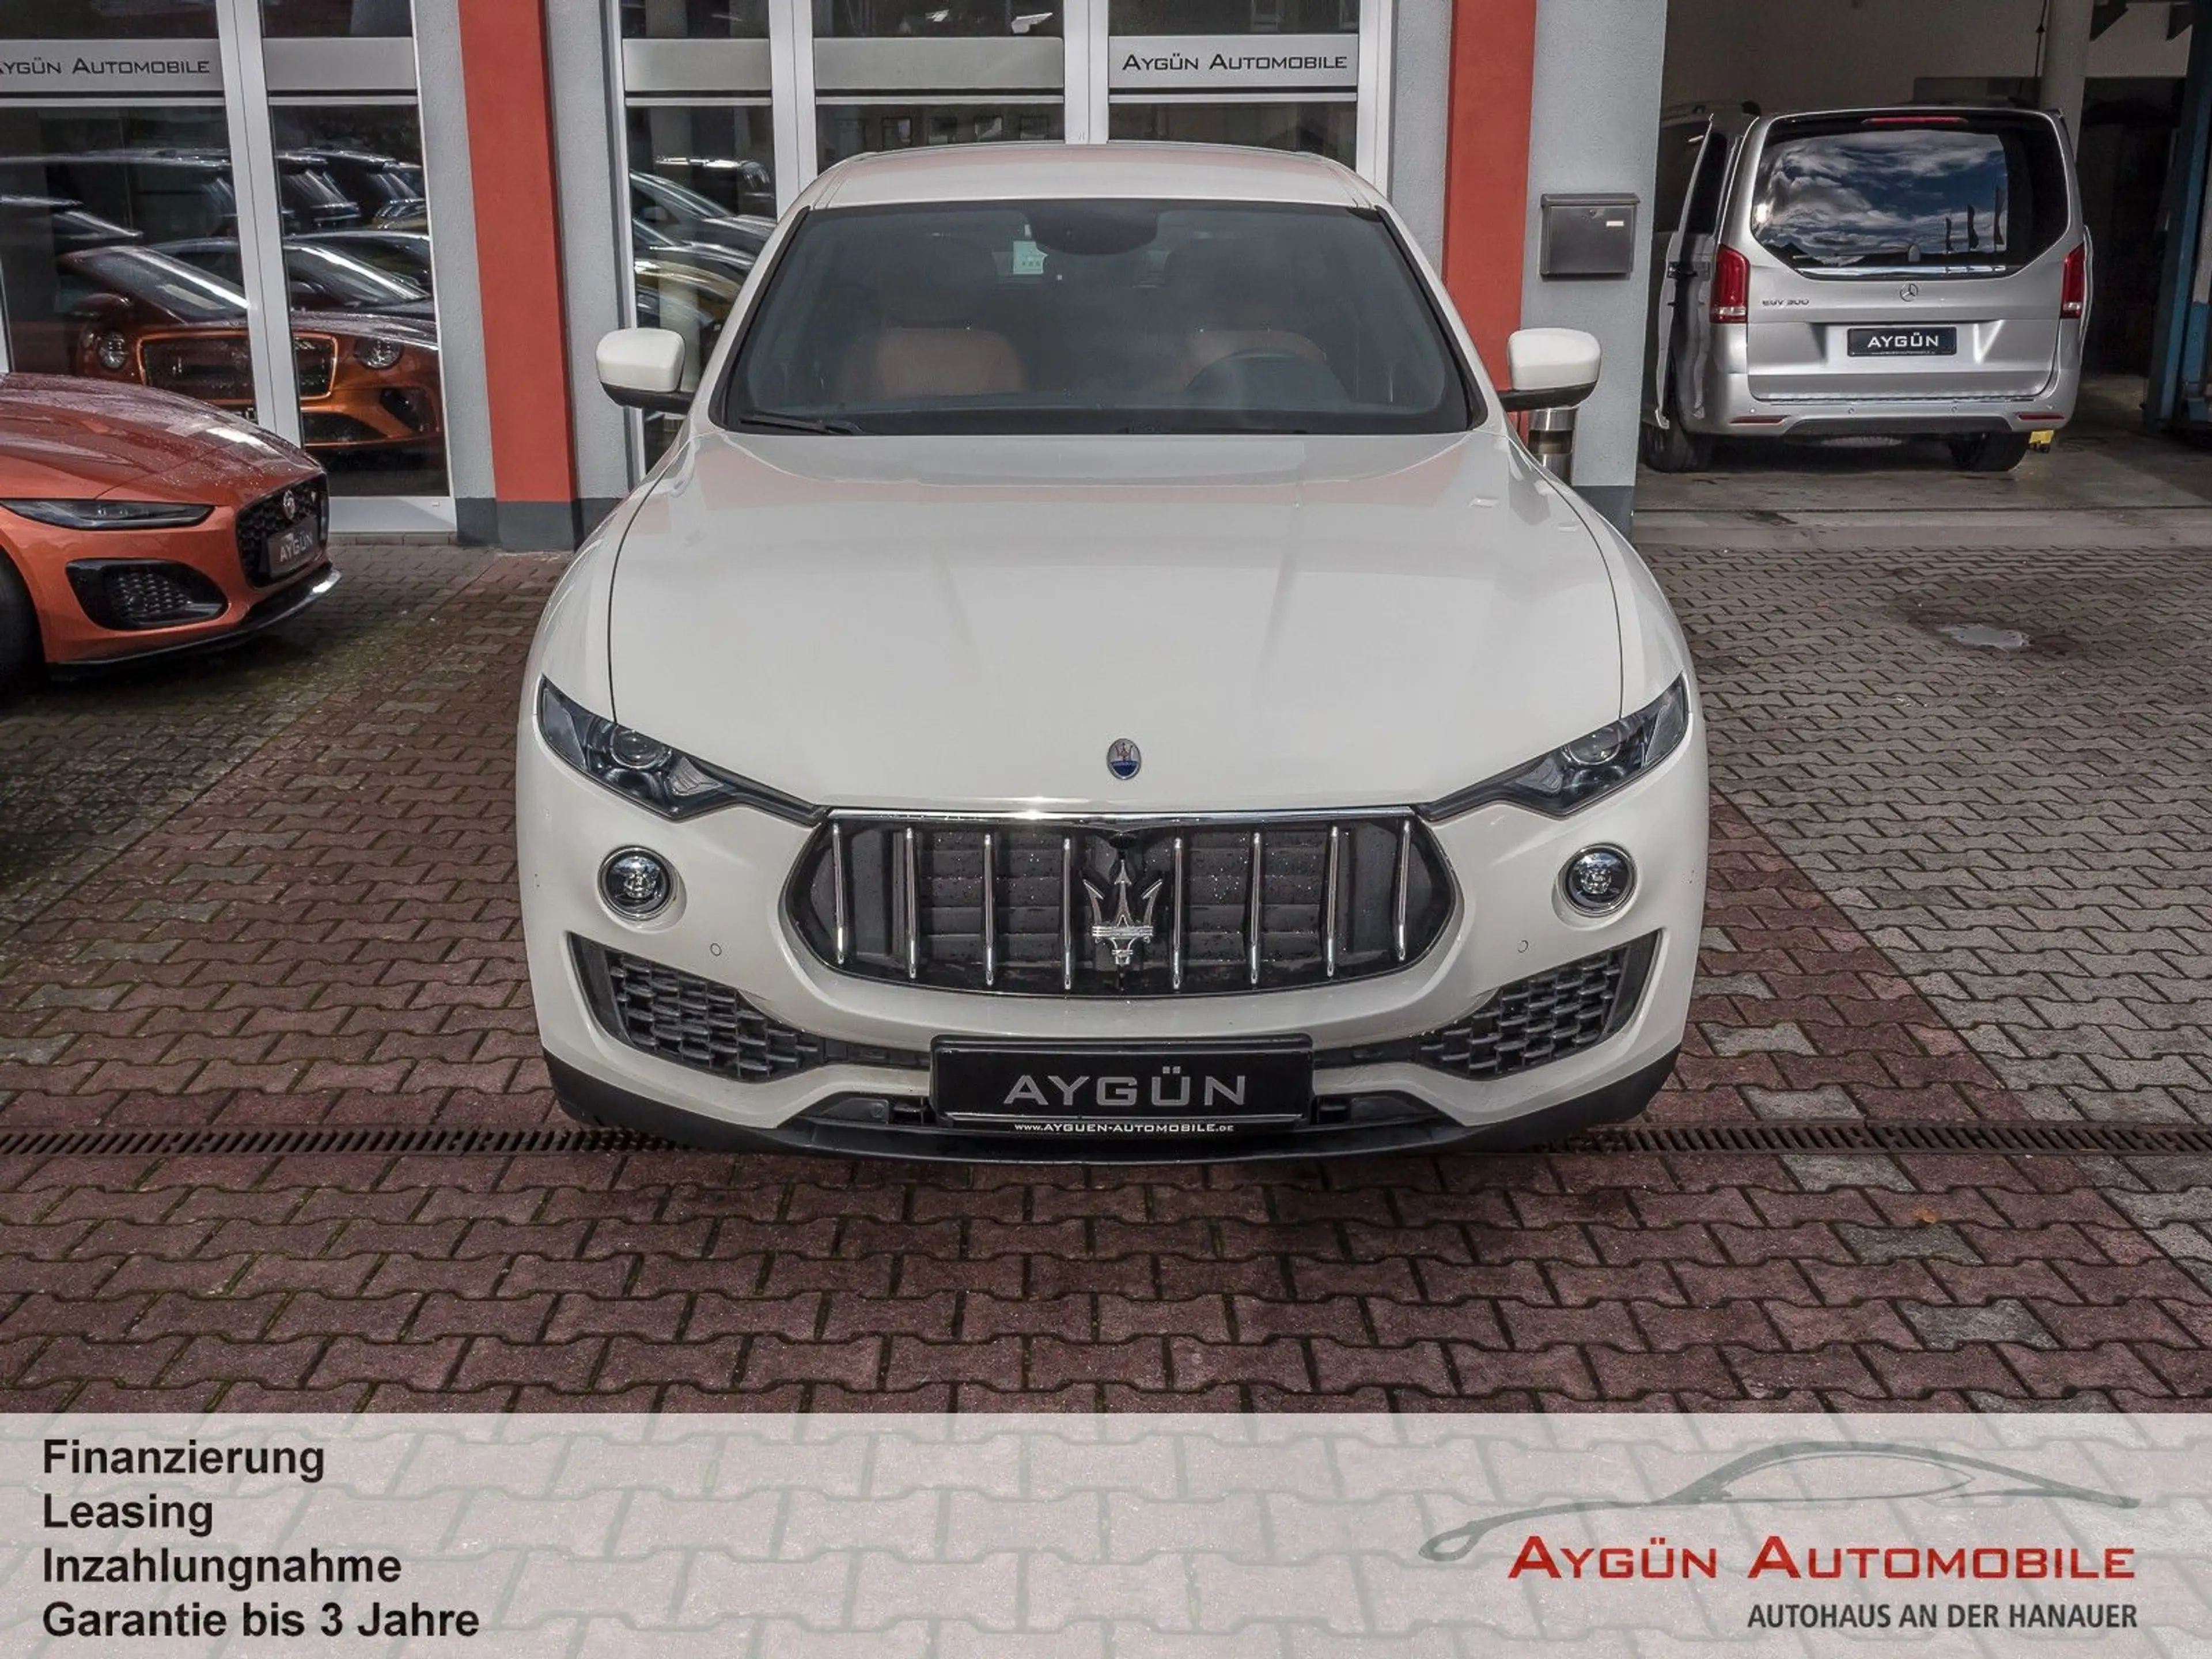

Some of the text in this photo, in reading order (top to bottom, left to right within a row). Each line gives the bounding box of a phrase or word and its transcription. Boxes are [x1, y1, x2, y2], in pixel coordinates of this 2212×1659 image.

[72, 58, 210, 74] AUTOMOBILE
[1122, 52, 1347, 70] AYGÜN AUTOMOBILE
[1867, 332, 1939, 348] AYGÜN
[279, 530, 313, 562] AYGÜN
[1003, 1066, 1246, 1106] AYGÜN
